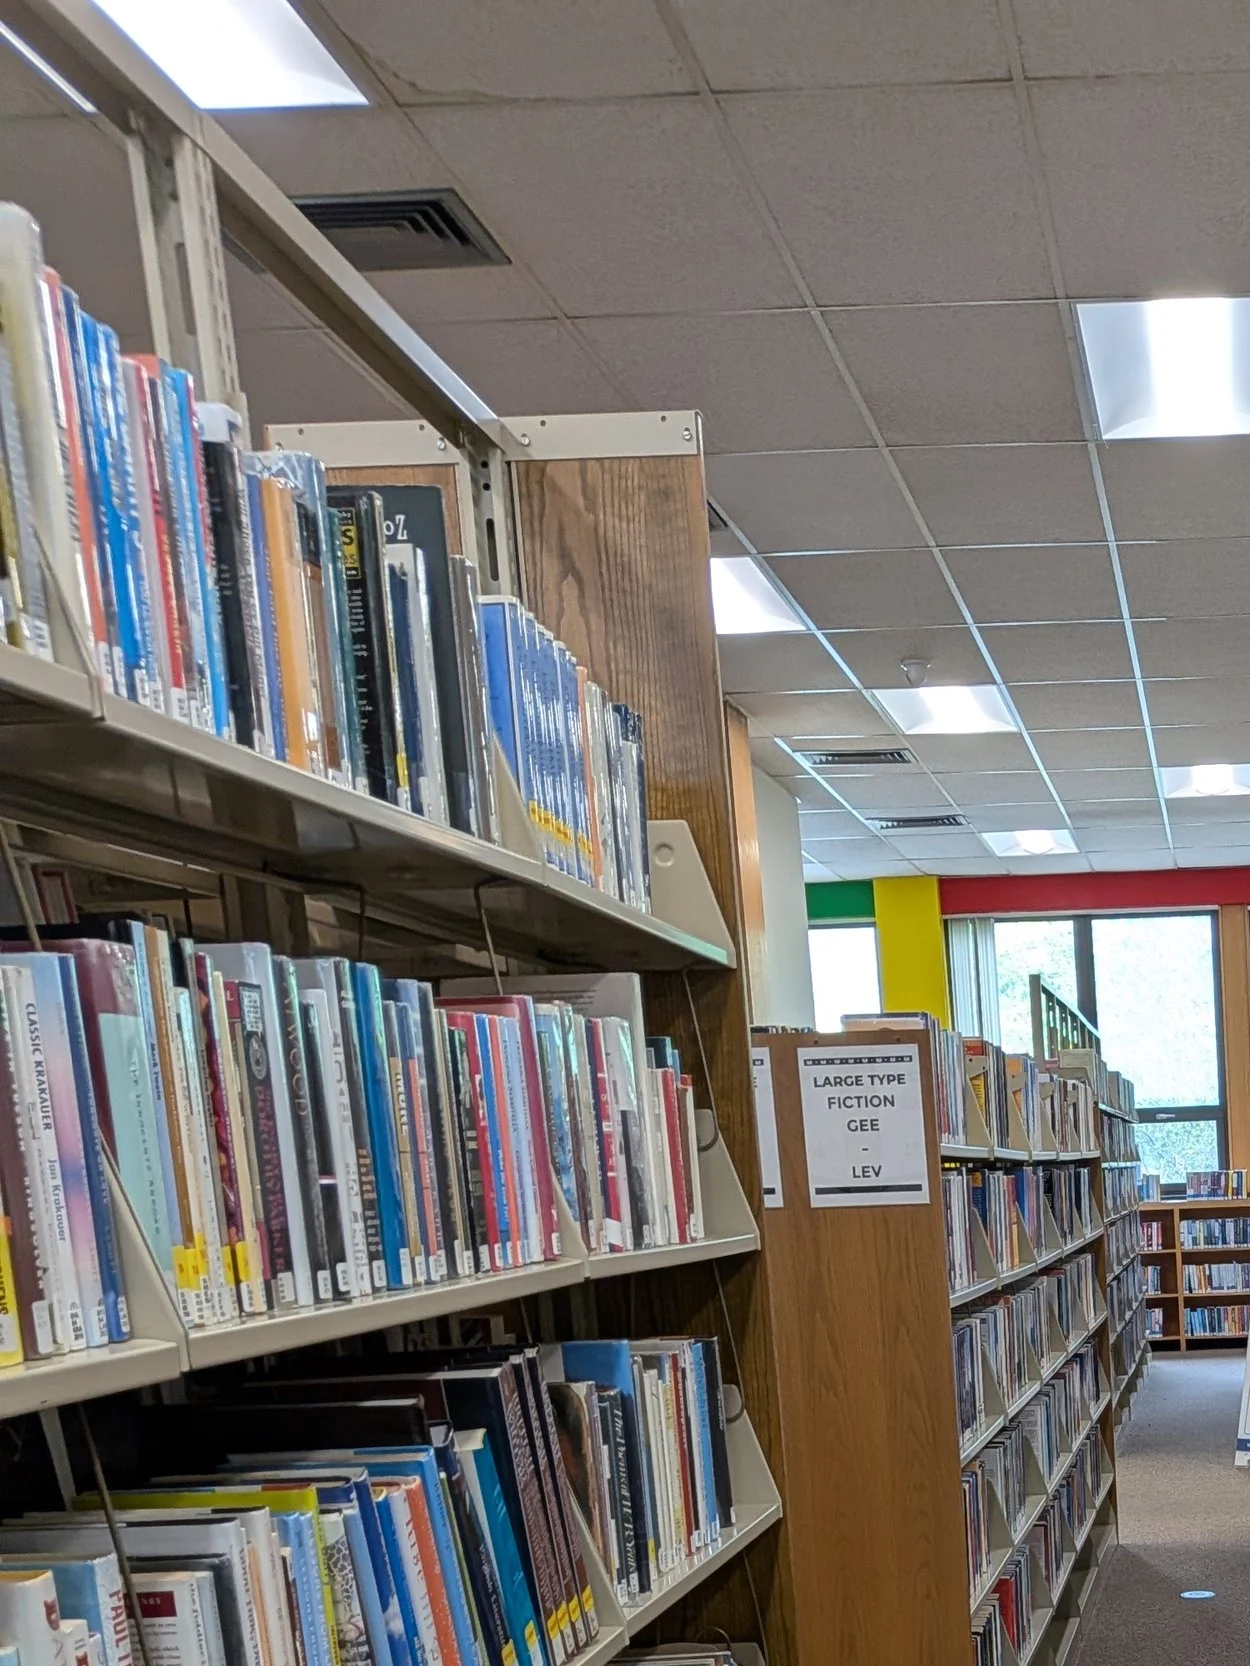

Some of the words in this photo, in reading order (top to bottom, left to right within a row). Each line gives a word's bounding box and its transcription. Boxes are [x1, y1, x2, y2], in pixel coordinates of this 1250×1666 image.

[25, 1003, 42, 1057] CLASSIC
[283, 988, 310, 1117] ATWOOD
[33, 1058, 51, 1132] KRAKAUER
[813, 1075, 864, 1088] LARGE
[868, 1073, 906, 1086] TYPE
[827, 1094, 895, 1110] FICTION
[847, 1119, 880, 1132] GEE
[47, 1158, 58, 1183] Jon
[852, 1165, 882, 1179] LEV
[51, 1184, 67, 1243] Krakauer
[108, 1587, 130, 1644] PAUL
